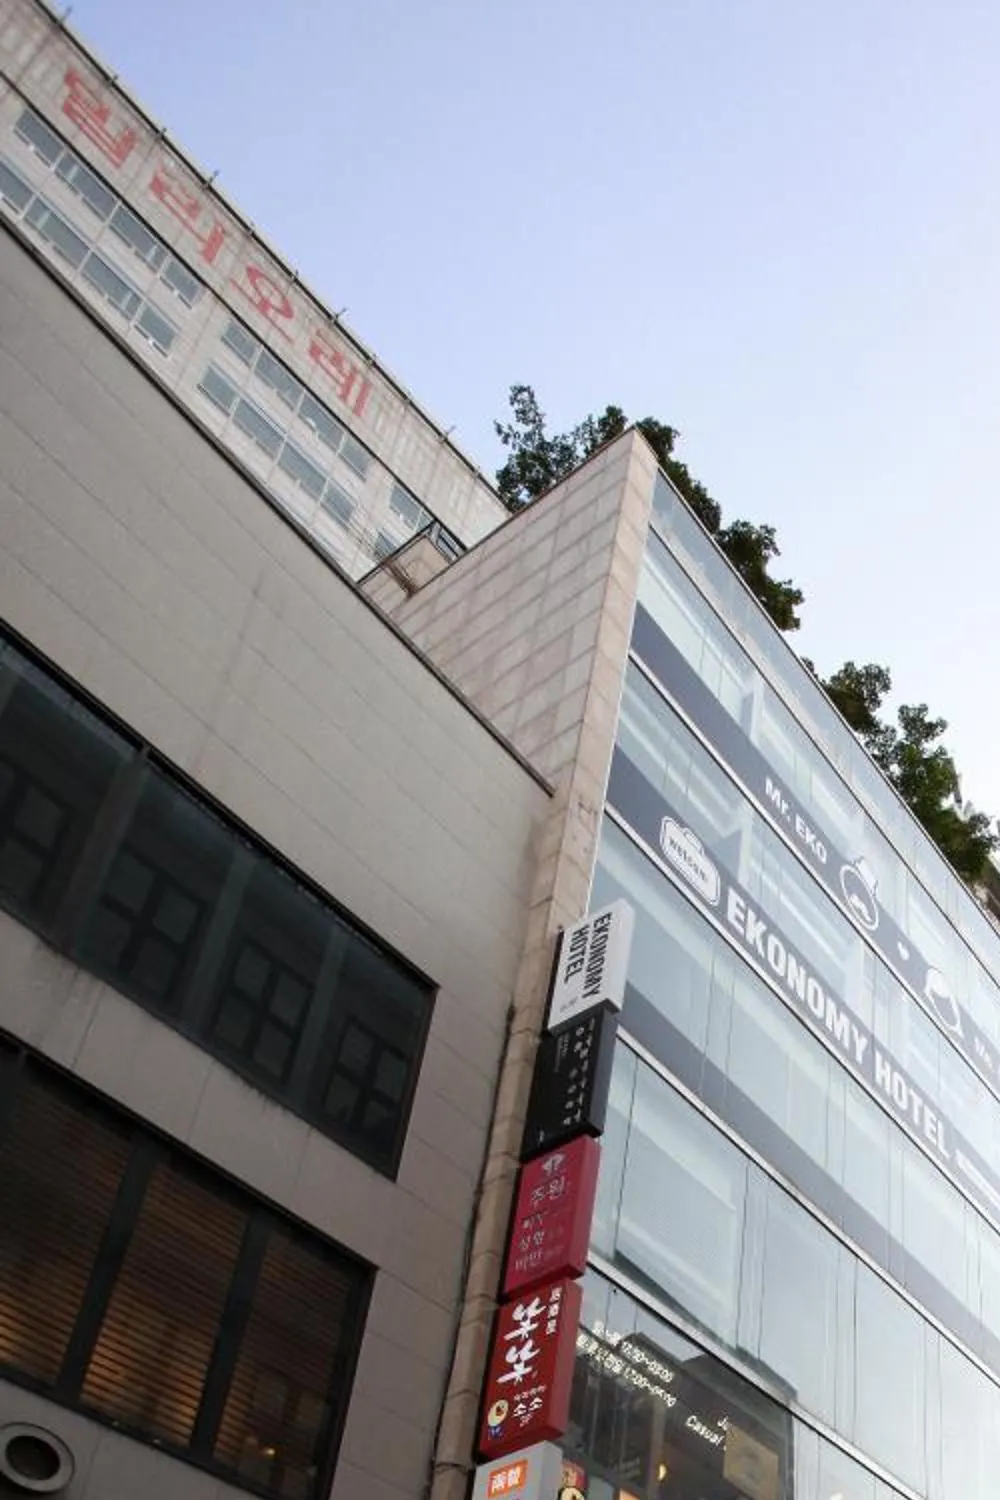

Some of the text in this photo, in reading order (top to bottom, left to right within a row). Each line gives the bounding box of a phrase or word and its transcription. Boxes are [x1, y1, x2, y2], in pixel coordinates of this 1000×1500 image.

[795, 814, 828, 865] EKO
[563, 924, 590, 985] HOTEL
[582, 911, 613, 999] EKONOMY
[727, 886, 952, 1160] EKONOMY HOTEL
